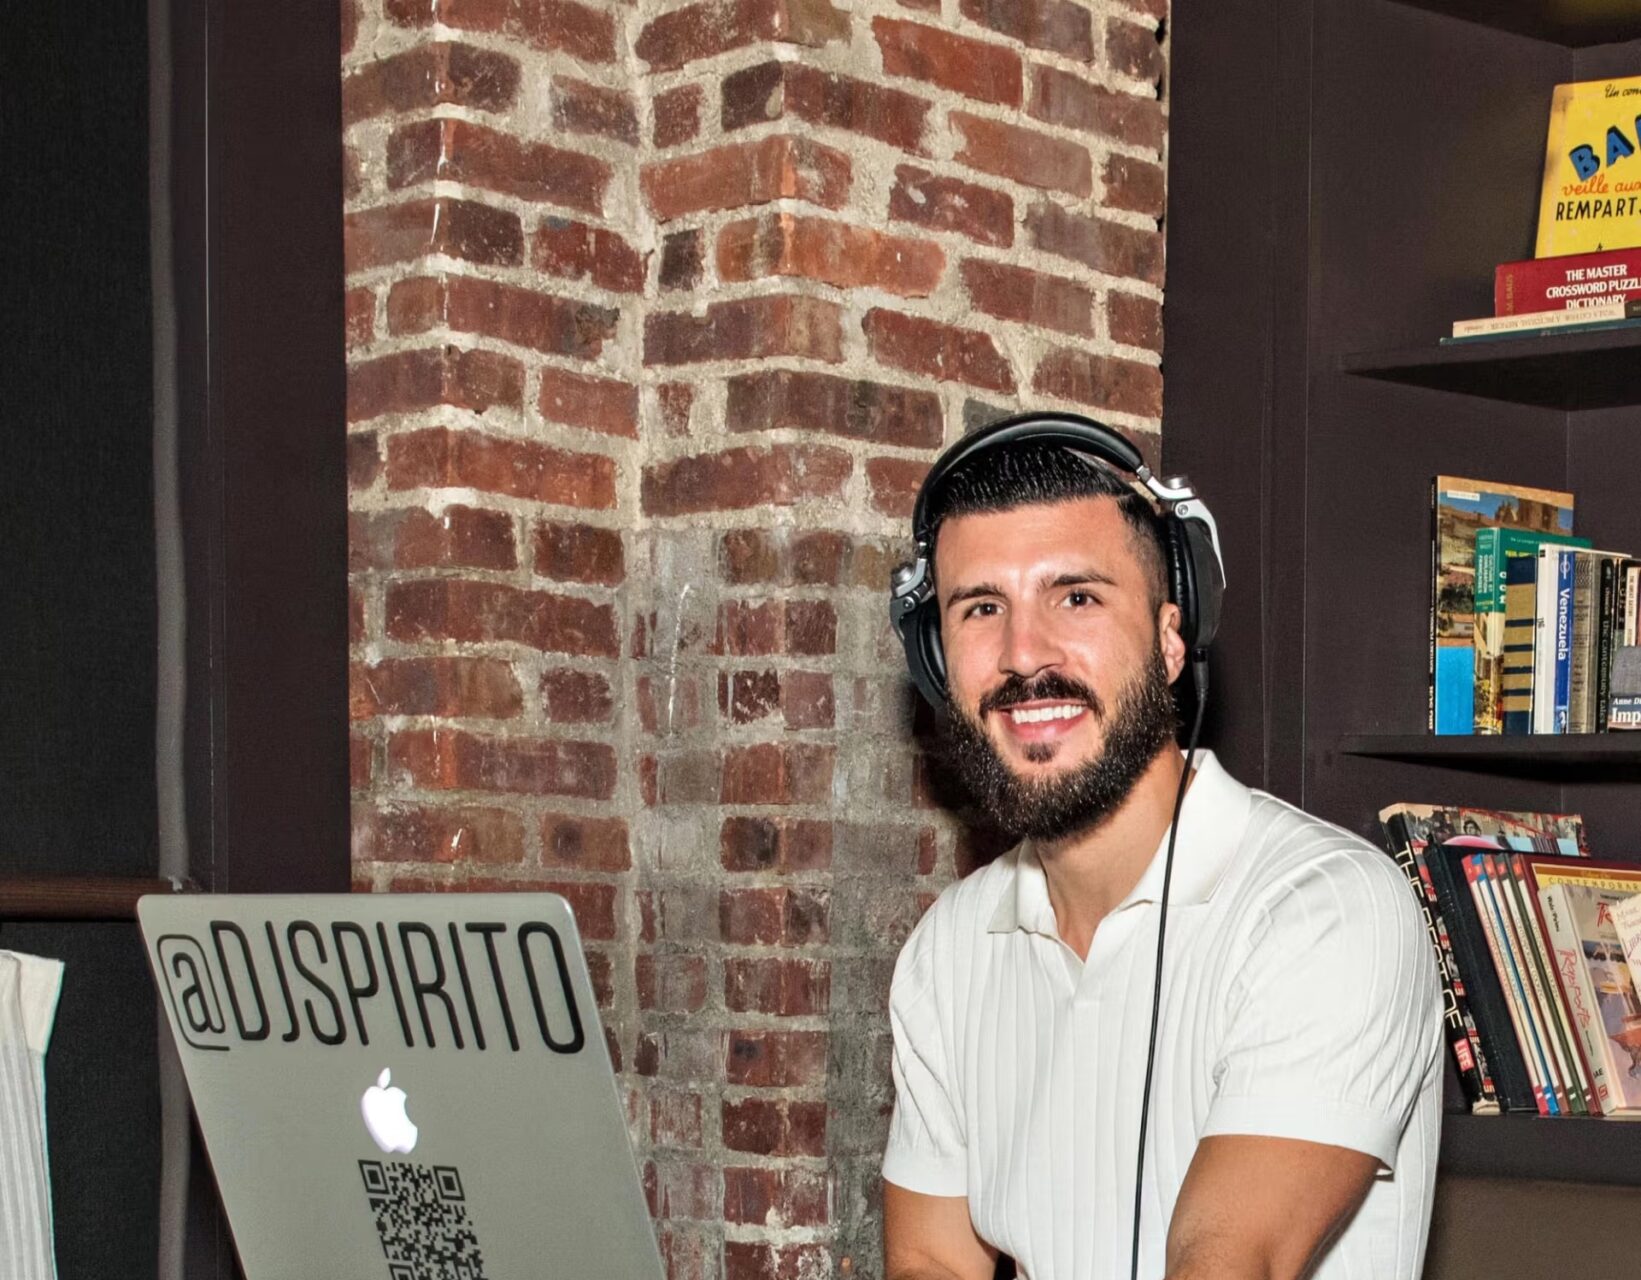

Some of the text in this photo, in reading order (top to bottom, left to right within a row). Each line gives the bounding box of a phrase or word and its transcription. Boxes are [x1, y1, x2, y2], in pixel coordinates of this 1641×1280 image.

[1568, 113, 1641, 182] BA
[1562, 173, 1609, 197] veille
[1556, 196, 1641, 222] REMPART
[1565, 263, 1628, 282] THE MASTER
[1546, 281, 1608, 299] CROSSWORD
[1566, 293, 1627, 311] DICTIONARY
[1557, 588, 1571, 660] Venezuela
[1612, 697, 1632, 705] Anne
[157, 920, 585, 1055] @DJSPIRITO
[1455, 1039, 1473, 1072] LIFE
